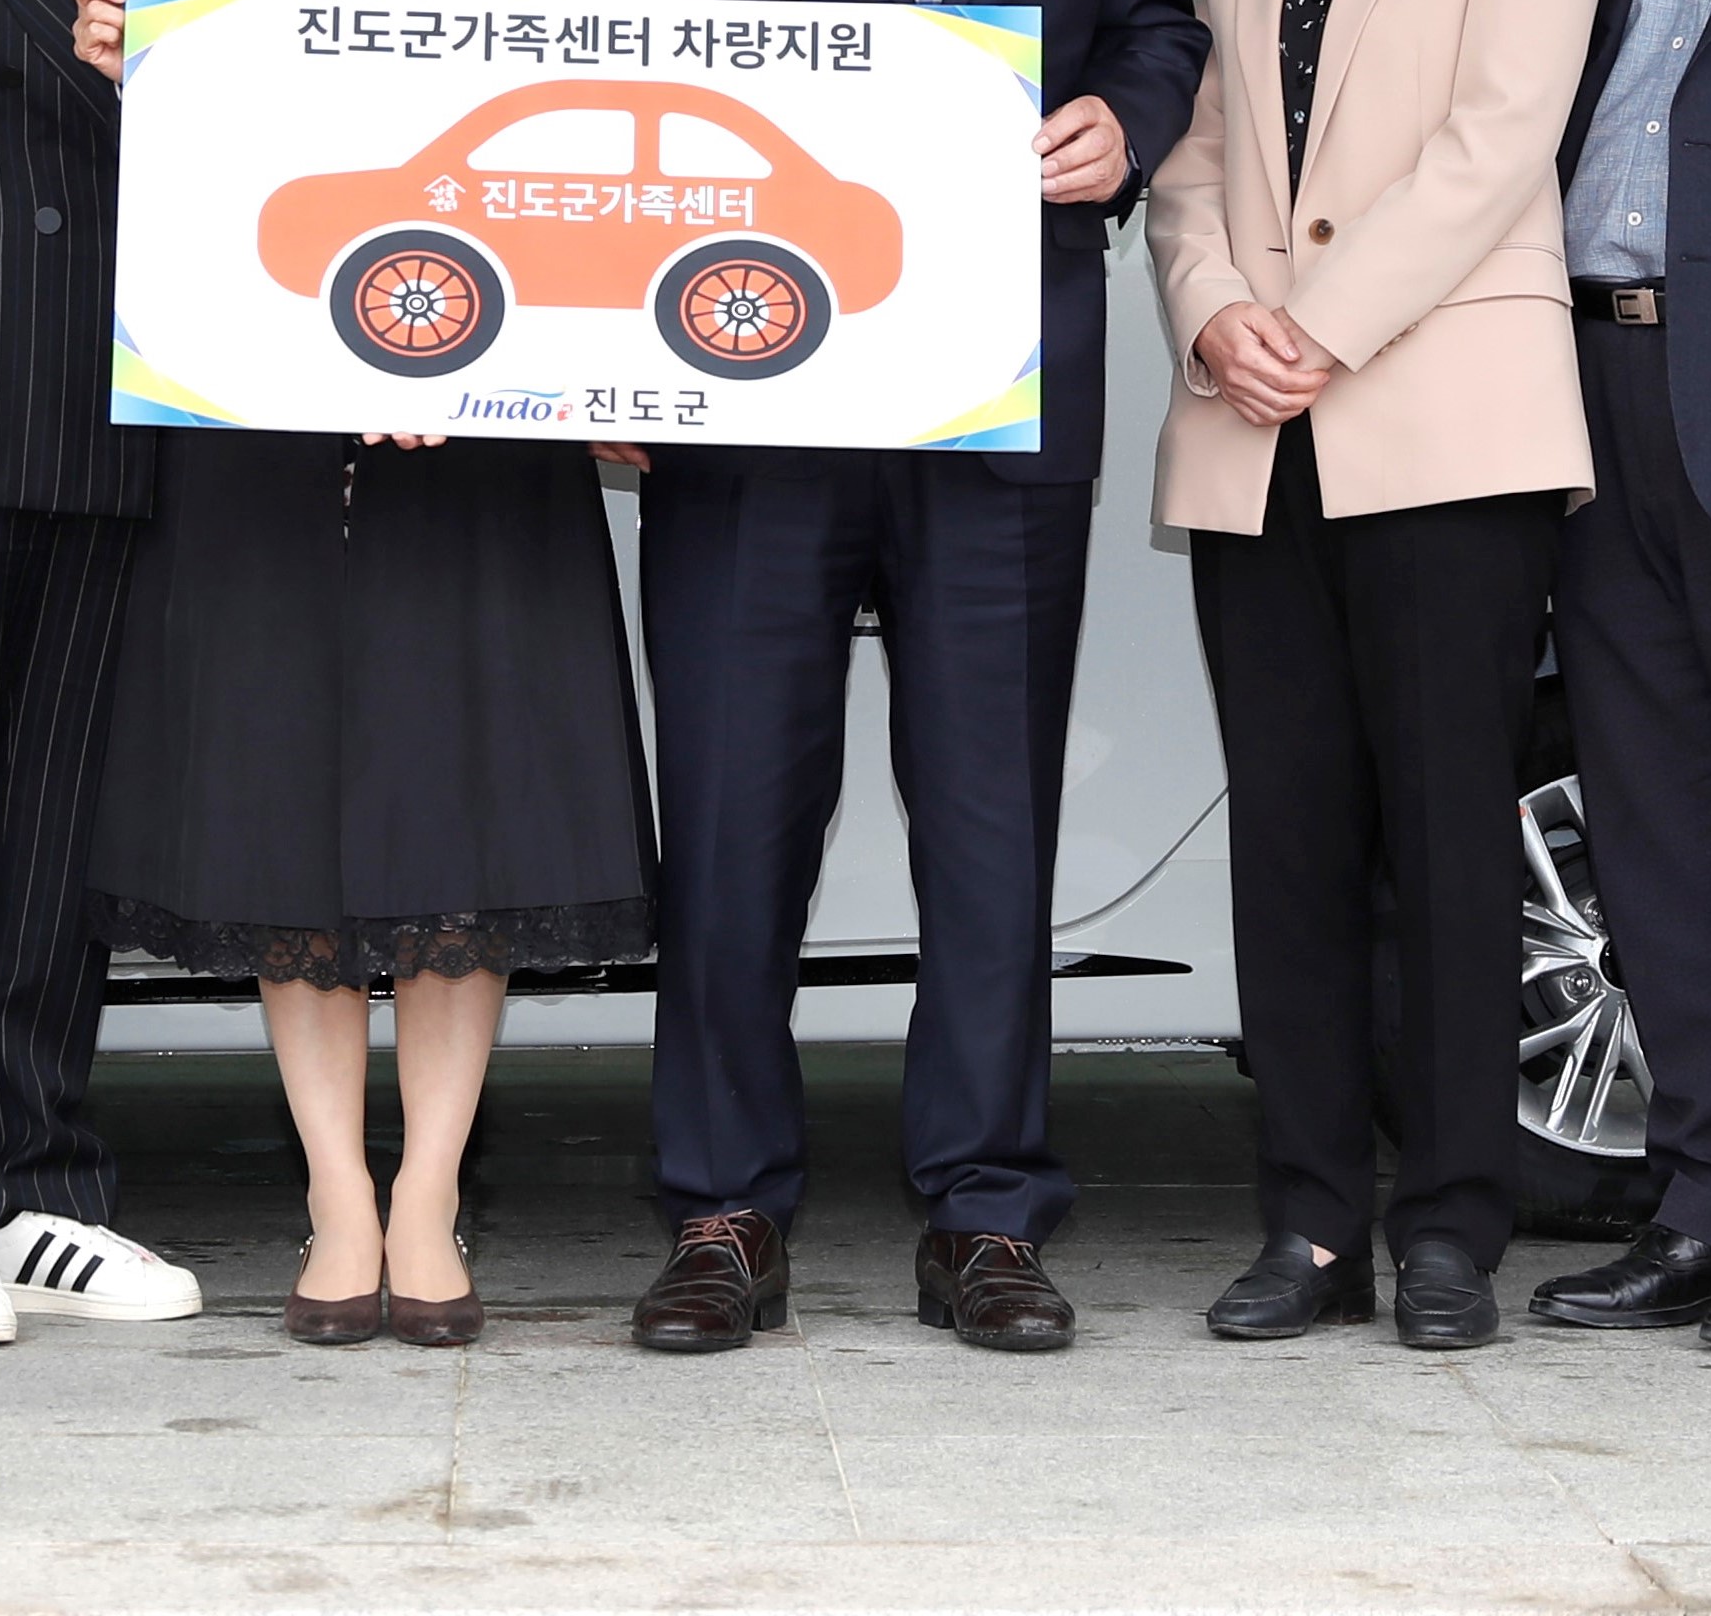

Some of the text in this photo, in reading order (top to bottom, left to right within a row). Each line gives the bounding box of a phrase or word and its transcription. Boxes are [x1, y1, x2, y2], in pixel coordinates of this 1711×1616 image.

[297, 5, 873, 72] 진도군가족센터 차량지원
[481, 179, 754, 227] 진도군가족센터
[448, 392, 553, 422] Jindo
[584, 386, 709, 426] 진도군
